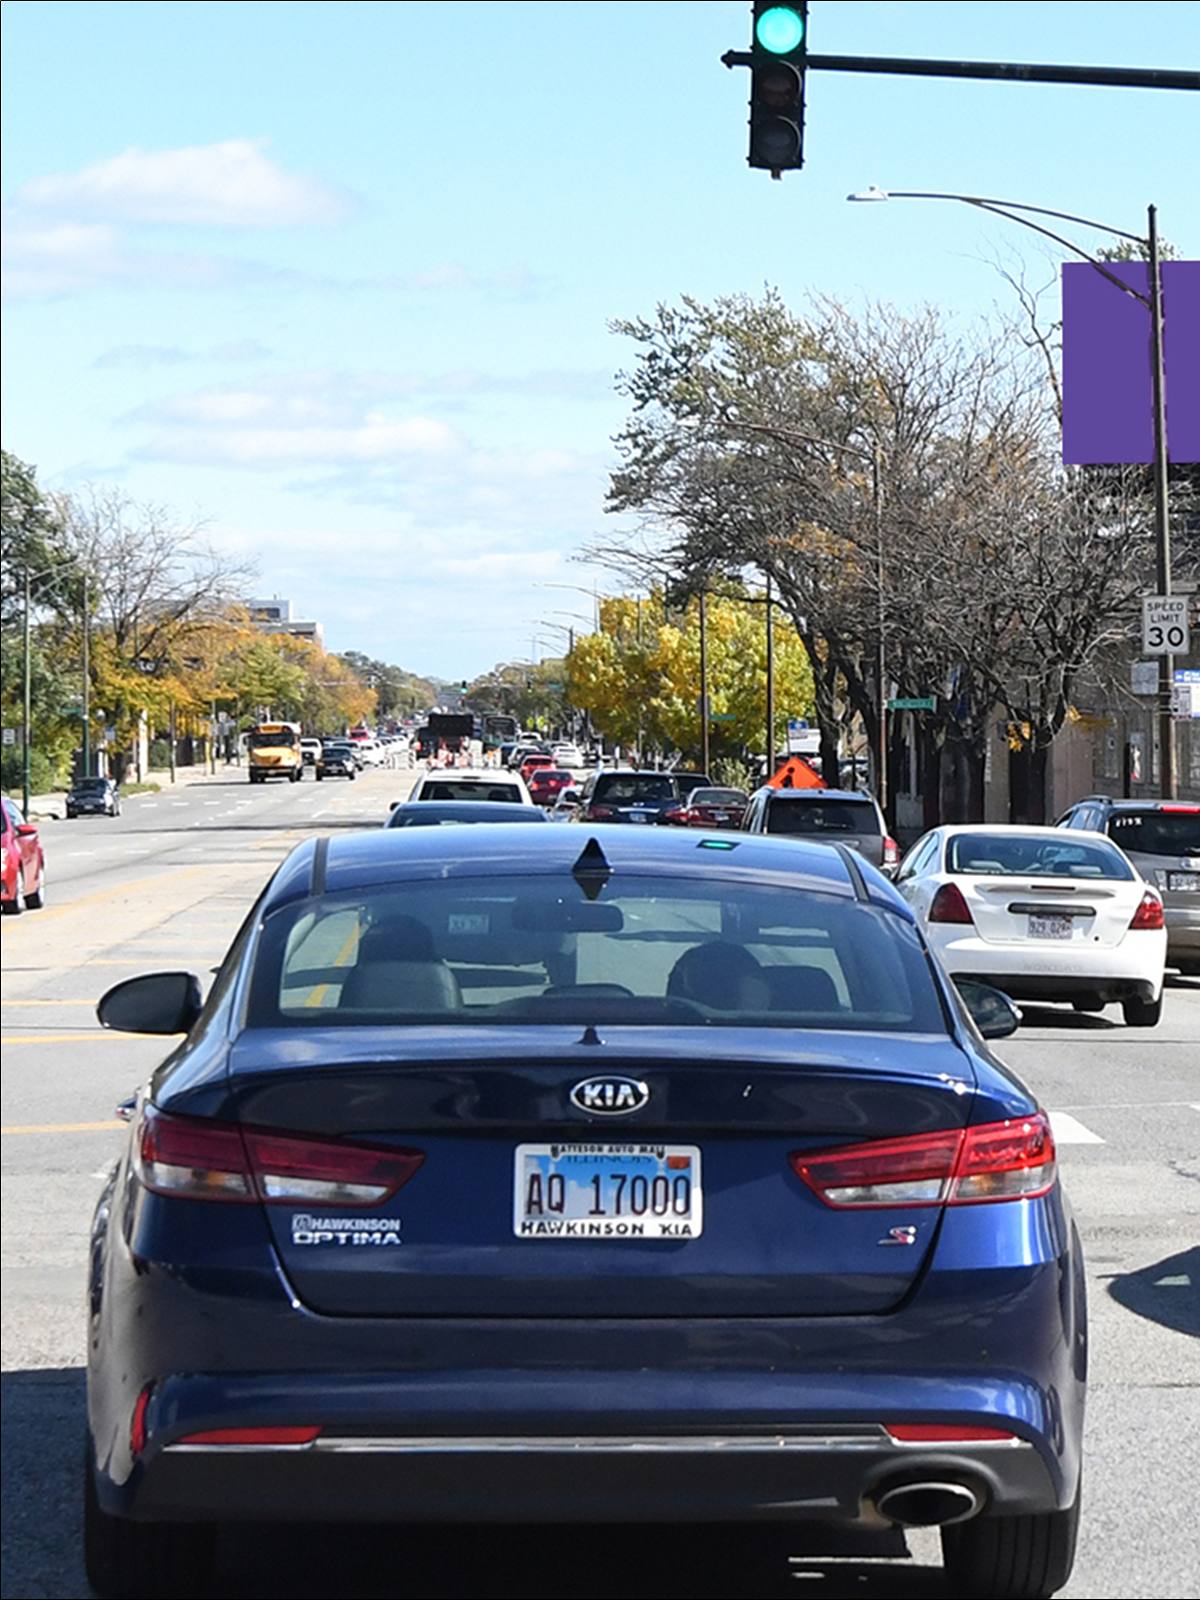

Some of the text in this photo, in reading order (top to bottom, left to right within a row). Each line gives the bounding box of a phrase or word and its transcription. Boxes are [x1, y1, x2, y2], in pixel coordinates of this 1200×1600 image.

[1147, 602, 1185, 612] SPEED
[1150, 614, 1180, 623] LIMIT
[1148, 626, 1184, 647] 30
[584, 1084, 636, 1106] KIA
[608, 1145, 635, 1153] AUTO
[526, 1174, 691, 1215] AQ 17000
[311, 1218, 401, 1231] HAWKINSON
[521, 1222, 692, 1235] HAWKINSON KIA
[293, 1232, 401, 1245] OPTIMA
